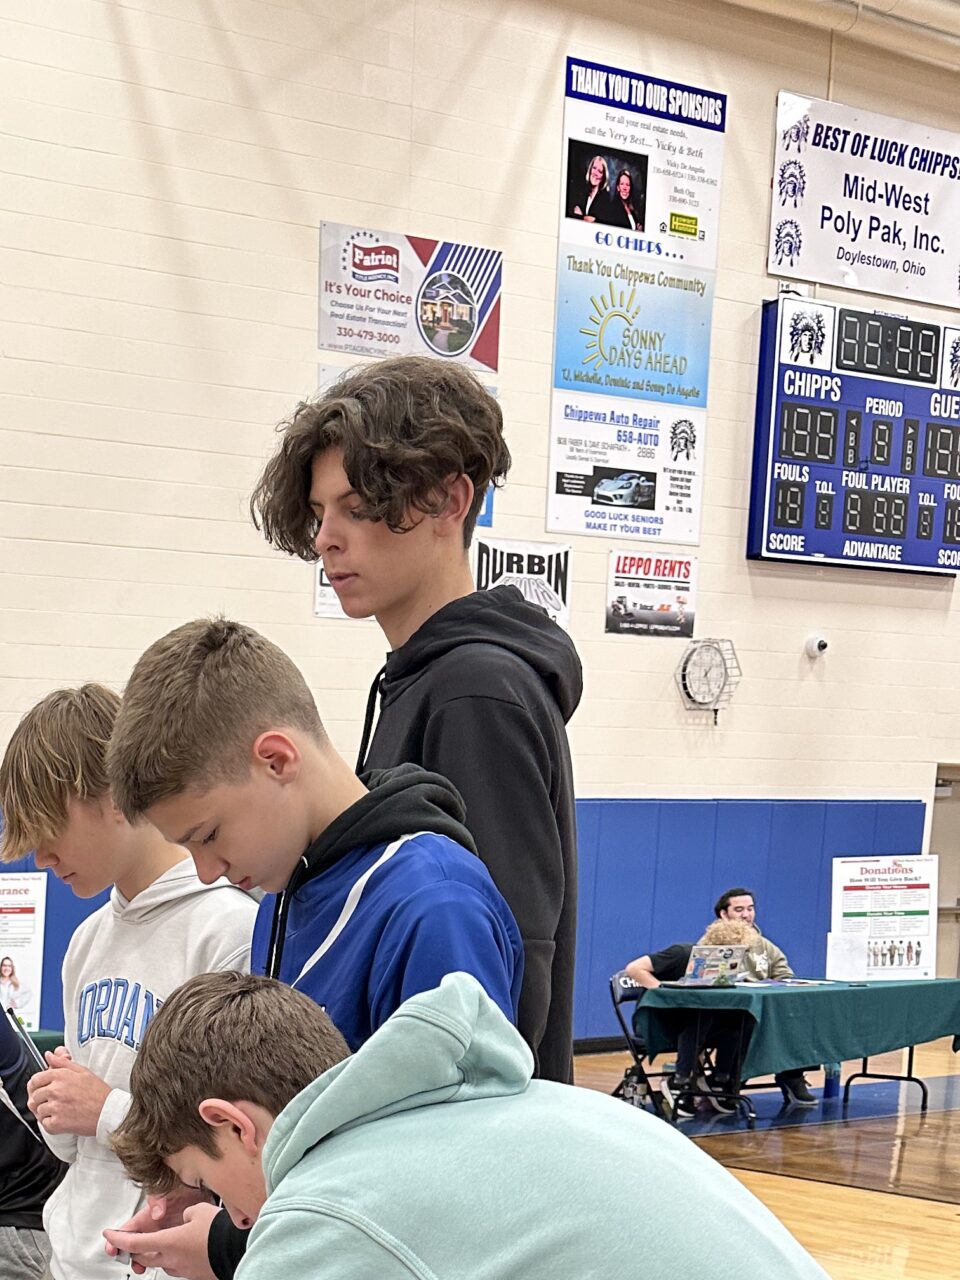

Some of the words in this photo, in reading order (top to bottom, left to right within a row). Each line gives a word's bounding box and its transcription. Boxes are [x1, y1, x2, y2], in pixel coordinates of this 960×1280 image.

[571, 64, 608, 98] THANK
[609, 72, 630, 104] YOU
[631, 79, 645, 107] TO
[645, 82, 668, 112] OUR
[668, 88, 722, 125] SPONSORS
[656, 139, 677, 154] Vicky
[686, 146, 703, 158] Beth
[812, 123, 851, 154] BEST
[850, 132, 870, 158] OF
[869, 136, 909, 167] LUCK
[843, 173, 930, 215] Mid-West
[595, 231, 613, 247] GO
[820, 205, 863, 242] Poly
[868, 216, 907, 250] Pak,
[913, 225, 945, 254] Inc.
[354, 247, 398, 269] Patriot
[836, 246, 899, 274] Doylestown,
[902, 260, 926, 276] Ohio
[567, 255, 593, 274] Thank
[596, 260, 612, 278] You
[614, 263, 656, 287] Chippewa
[658, 271, 707, 297] Community
[325, 280, 342, 294] It's
[344, 283, 371, 299] Your
[374, 289, 412, 305] Choice
[337, 326, 400, 344] 330-479-3000
[622, 328, 666, 352] SONNY
[608, 346, 642, 369] DAYS
[644, 351, 688, 375] AHEAD
[783, 369, 841, 401] CHIPPS
[564, 404, 607, 422] Chippewa
[609, 411, 630, 425] Auto
[632, 413, 660, 429] Repair
[865, 396, 903, 418] PERIOD
[930, 392, 960, 419] GUE
[616, 429, 659, 447] 658-AUTO
[774, 462, 809, 482] FOULS
[841, 471, 868, 490] FOUL
[871, 475, 911, 494] PLAYER
[584, 509, 607, 520] GOOD
[608, 511, 629, 521] LUCK
[631, 513, 664, 525] SENIORS
[585, 521, 607, 532] MAKE
[609, 523, 617, 532] IT
[619, 523, 640, 534] YOUR
[642, 526, 662, 536] BEST
[769, 532, 805, 551] SCORE
[843, 540, 902, 561] ADVANTAGE
[476, 541, 569, 607] DURBIN
[615, 555, 652, 576] LEPPO
[653, 558, 691, 579] RENTS
[860, 866, 914, 876] Donations
